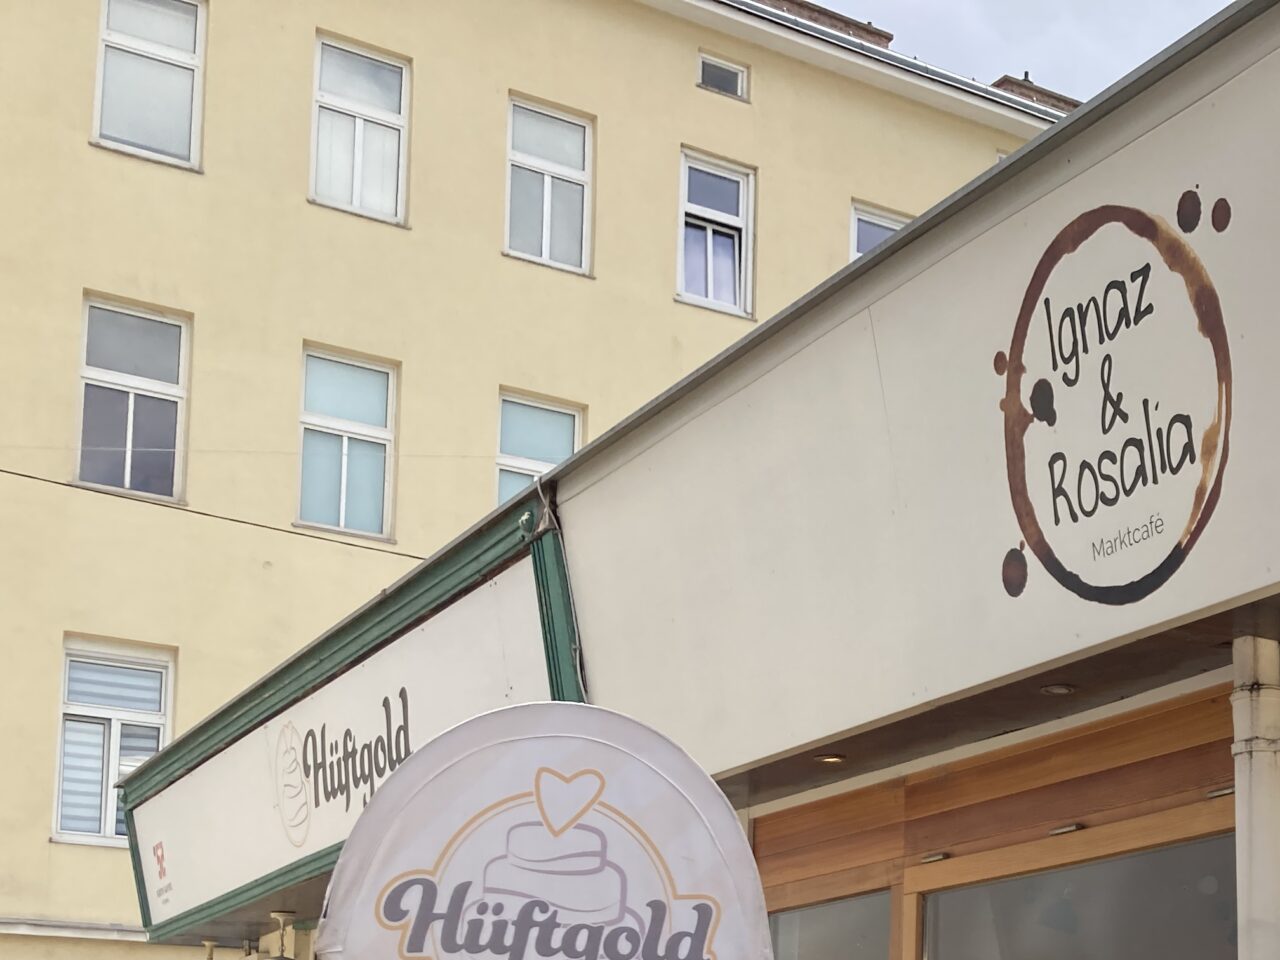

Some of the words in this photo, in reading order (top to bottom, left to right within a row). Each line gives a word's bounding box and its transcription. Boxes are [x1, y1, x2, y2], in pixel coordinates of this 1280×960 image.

[1044, 262, 1154, 387] Ignaz
[1101, 354, 1129, 434] &
[1047, 399, 1197, 526] Rosalia
[1091, 512, 1165, 562] Marktcafé
[302, 686, 413, 813] Hüftgold
